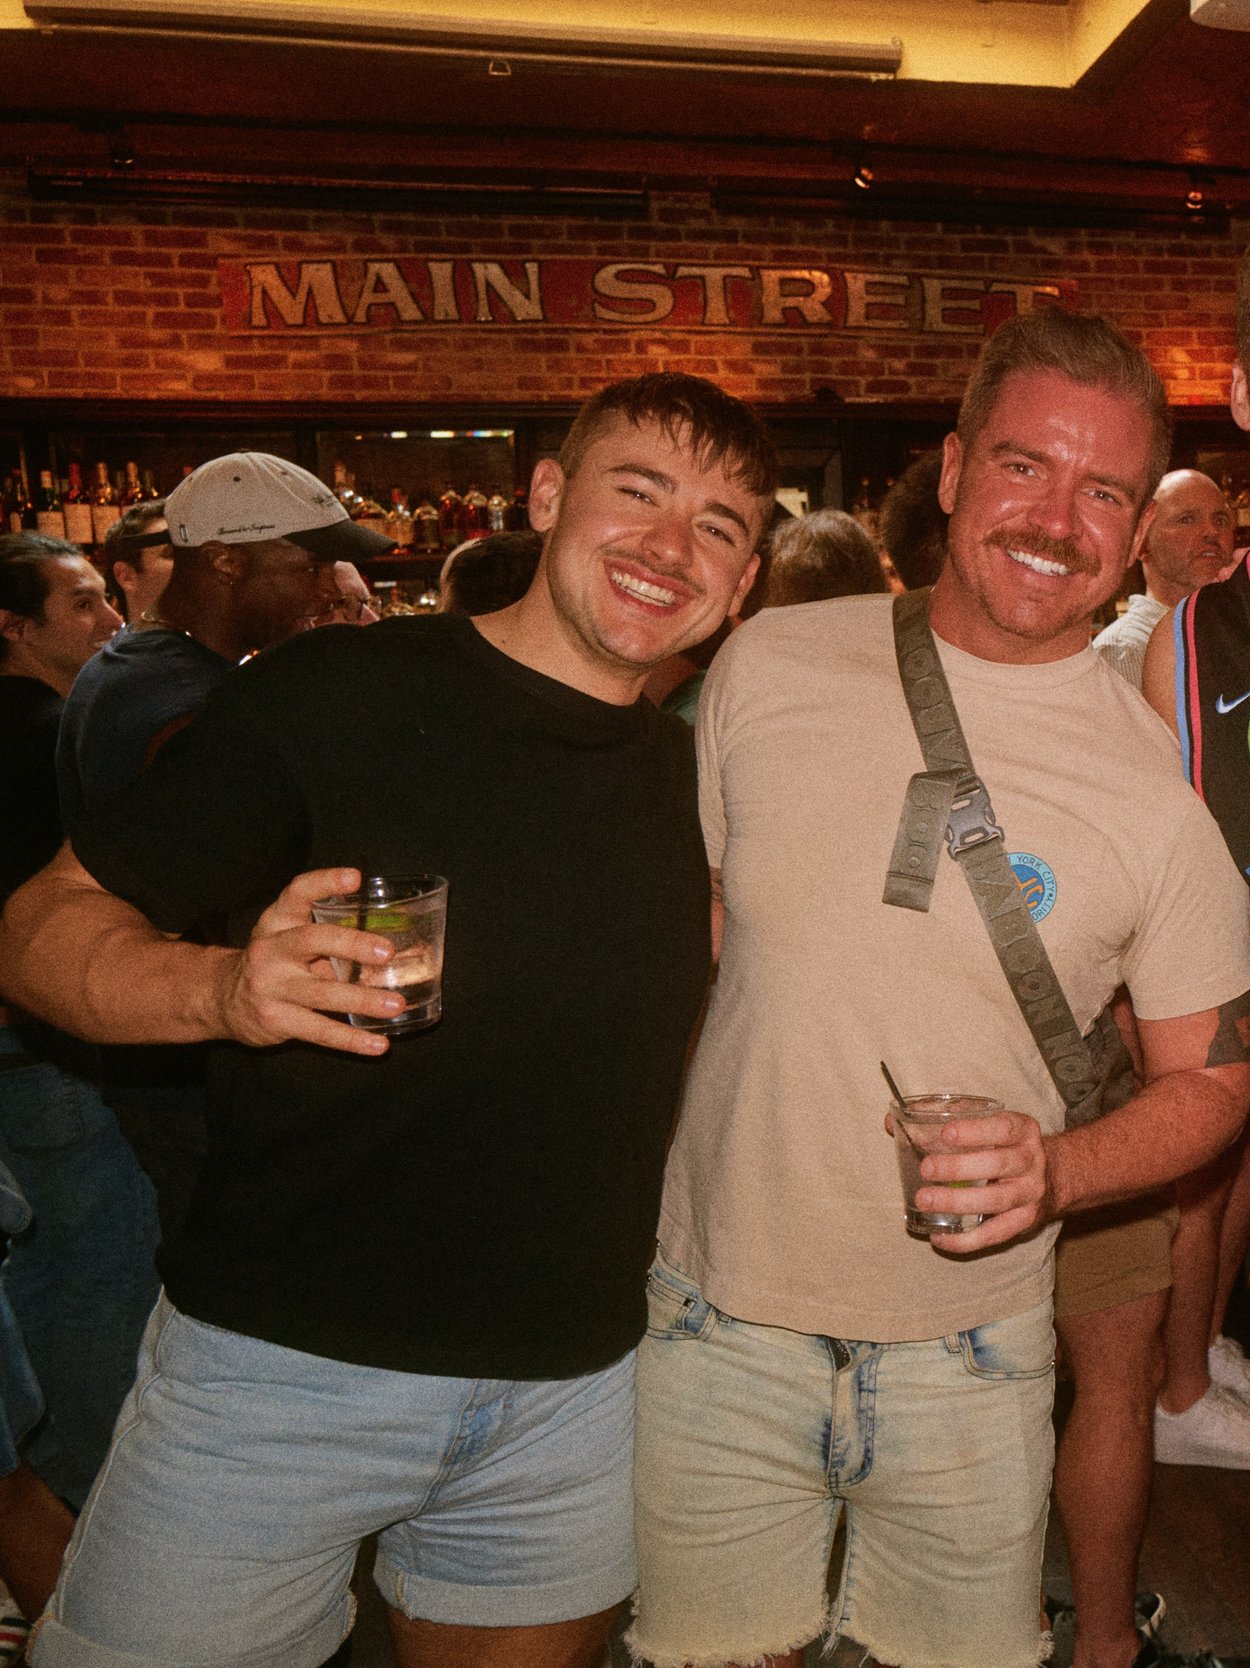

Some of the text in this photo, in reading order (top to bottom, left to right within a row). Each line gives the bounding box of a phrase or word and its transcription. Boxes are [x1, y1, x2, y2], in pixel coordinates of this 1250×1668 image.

[246, 261, 1061, 335] MAIN STREET
[1016, 855, 1055, 893] YORK CITY
[1031, 896, 1053, 920] ORITY
